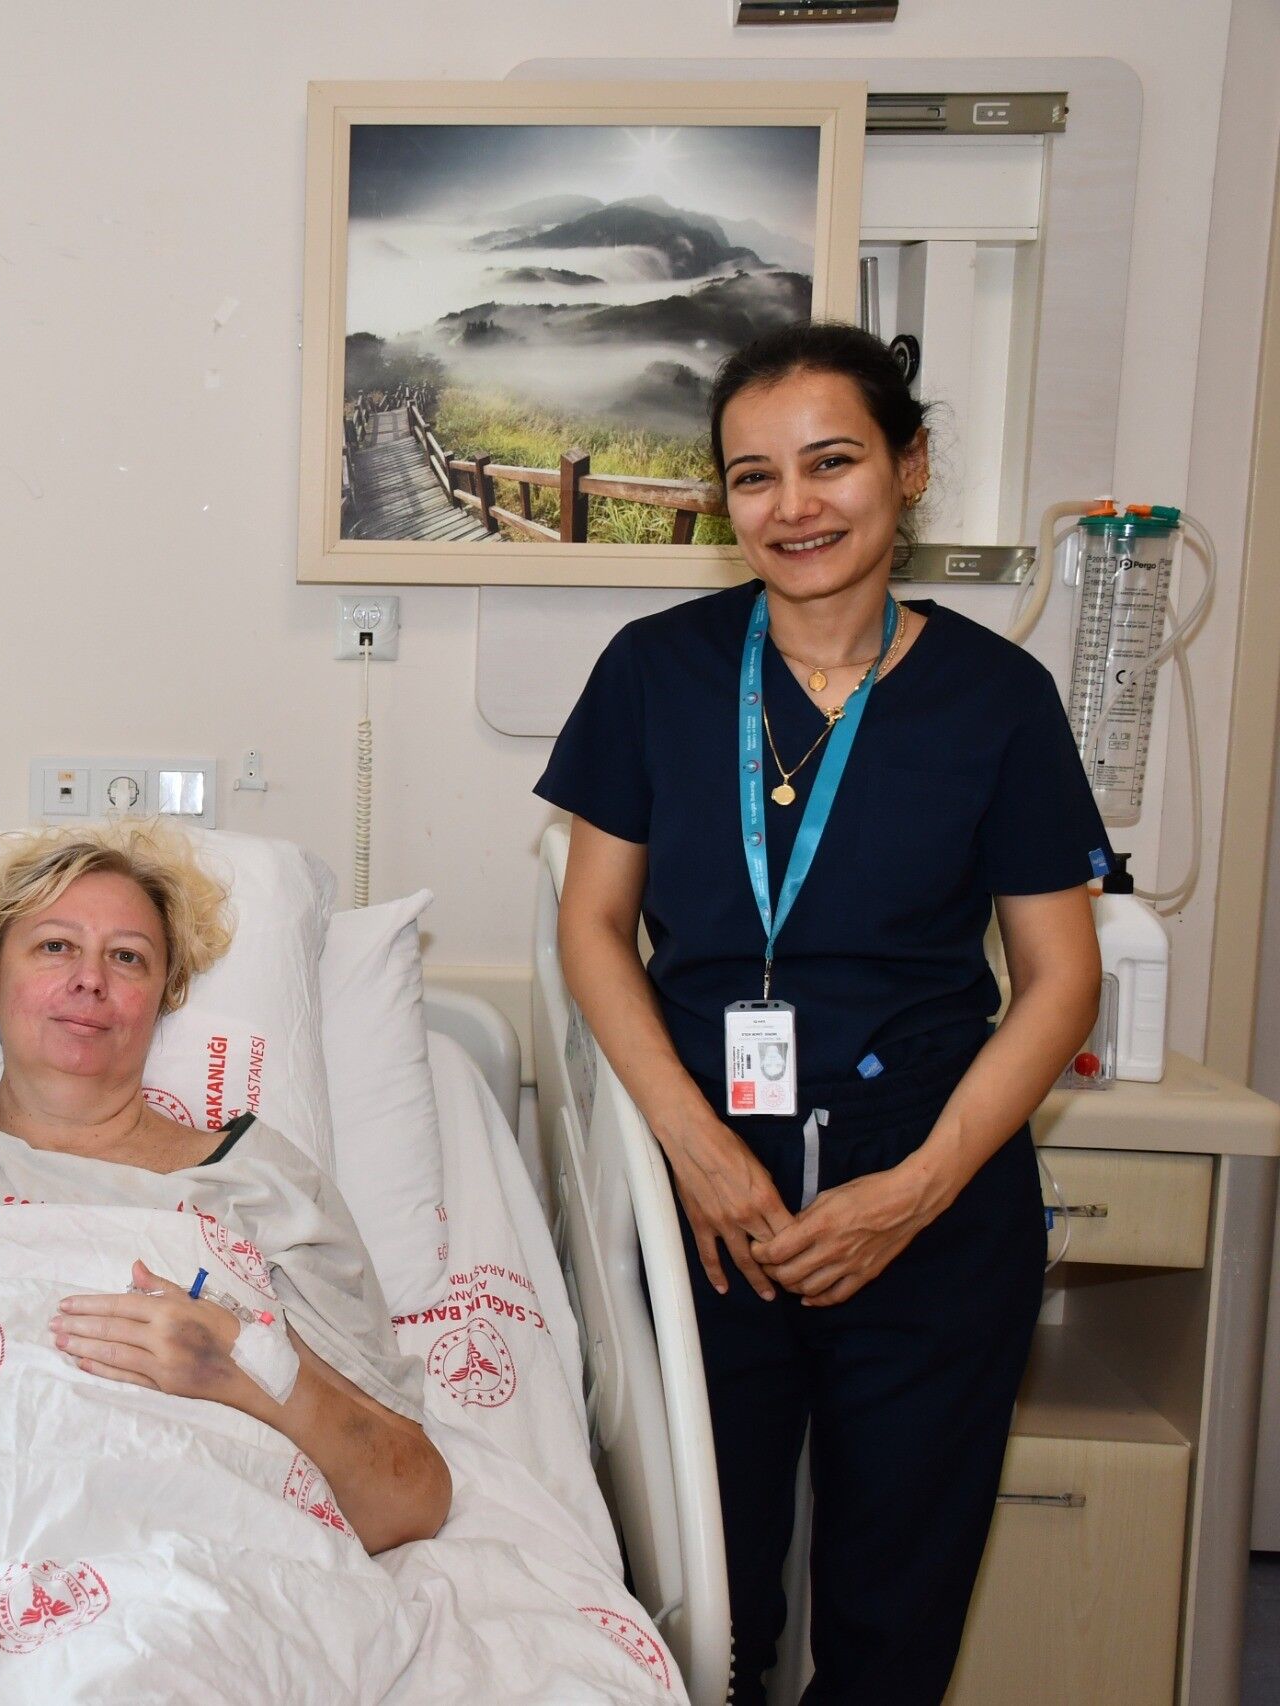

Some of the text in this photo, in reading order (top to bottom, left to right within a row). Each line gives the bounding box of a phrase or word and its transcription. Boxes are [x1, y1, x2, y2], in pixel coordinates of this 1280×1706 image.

[1134, 561, 1156, 570] Pergo
[206, 1036, 228, 1131] BAKANLIĞI
[247, 1036, 265, 1114] HASTANESİ
[465, 1294, 526, 1322] SAĞLIK
